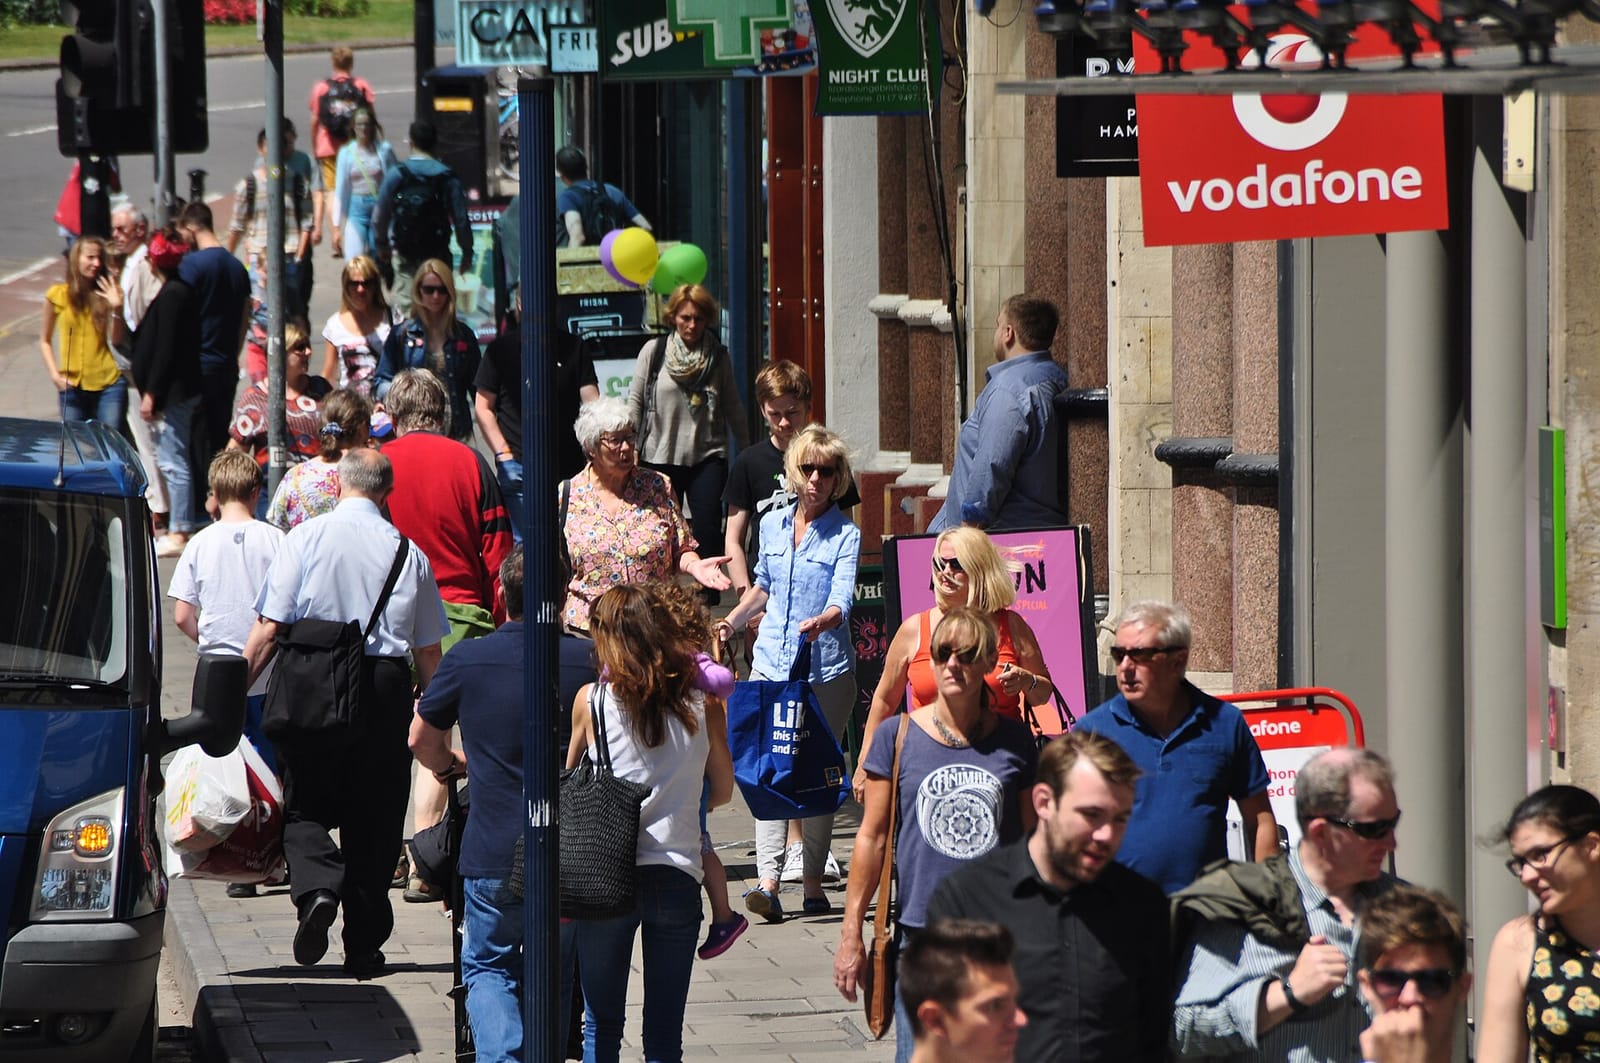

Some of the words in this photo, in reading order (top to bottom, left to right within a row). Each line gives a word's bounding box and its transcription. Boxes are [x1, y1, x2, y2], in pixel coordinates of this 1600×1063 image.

[558, 32, 597, 50] FRI
[828, 69, 879, 84] NIGHT
[876, 94, 896, 102] 0117
[1167, 160, 1423, 213] vodafone
[1015, 600, 1048, 610] SPECIAL
[1250, 720, 1301, 737] afone
[773, 730, 791, 741] this
[772, 744, 790, 754] and
